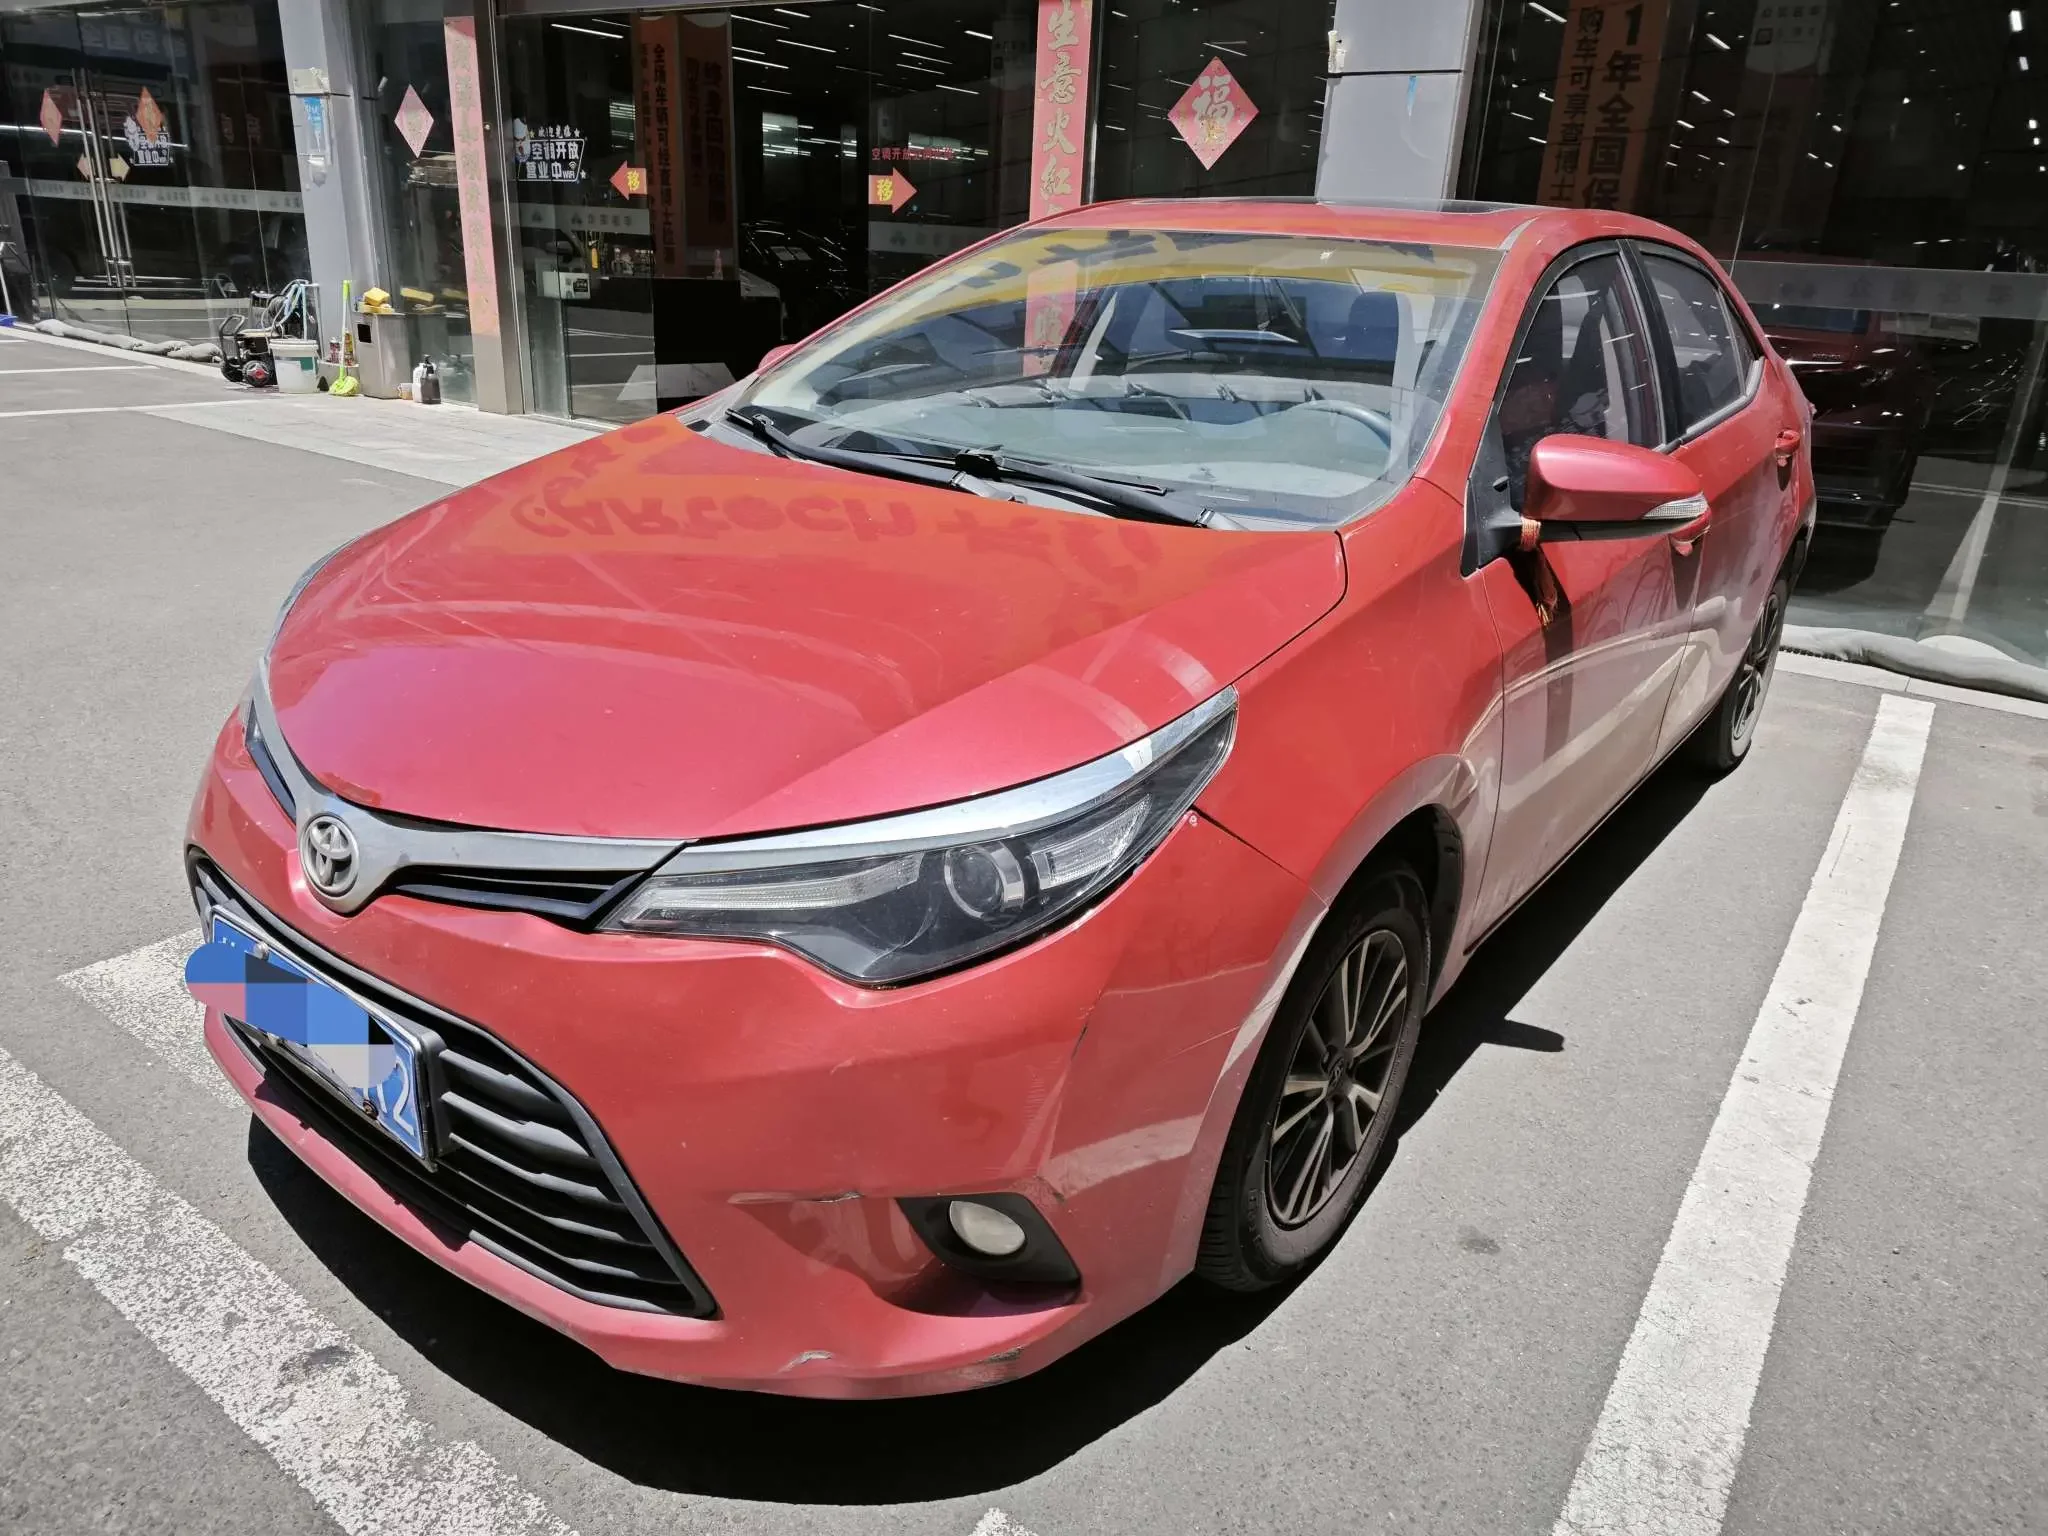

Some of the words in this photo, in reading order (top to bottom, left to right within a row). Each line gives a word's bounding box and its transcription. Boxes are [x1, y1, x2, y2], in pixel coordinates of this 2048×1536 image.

[1550, 7, 1604, 201] 购车可享查博士
[532, 141, 579, 160] 空调开放
[526, 161, 562, 179] 营业中
[877, 178, 893, 202] 移
